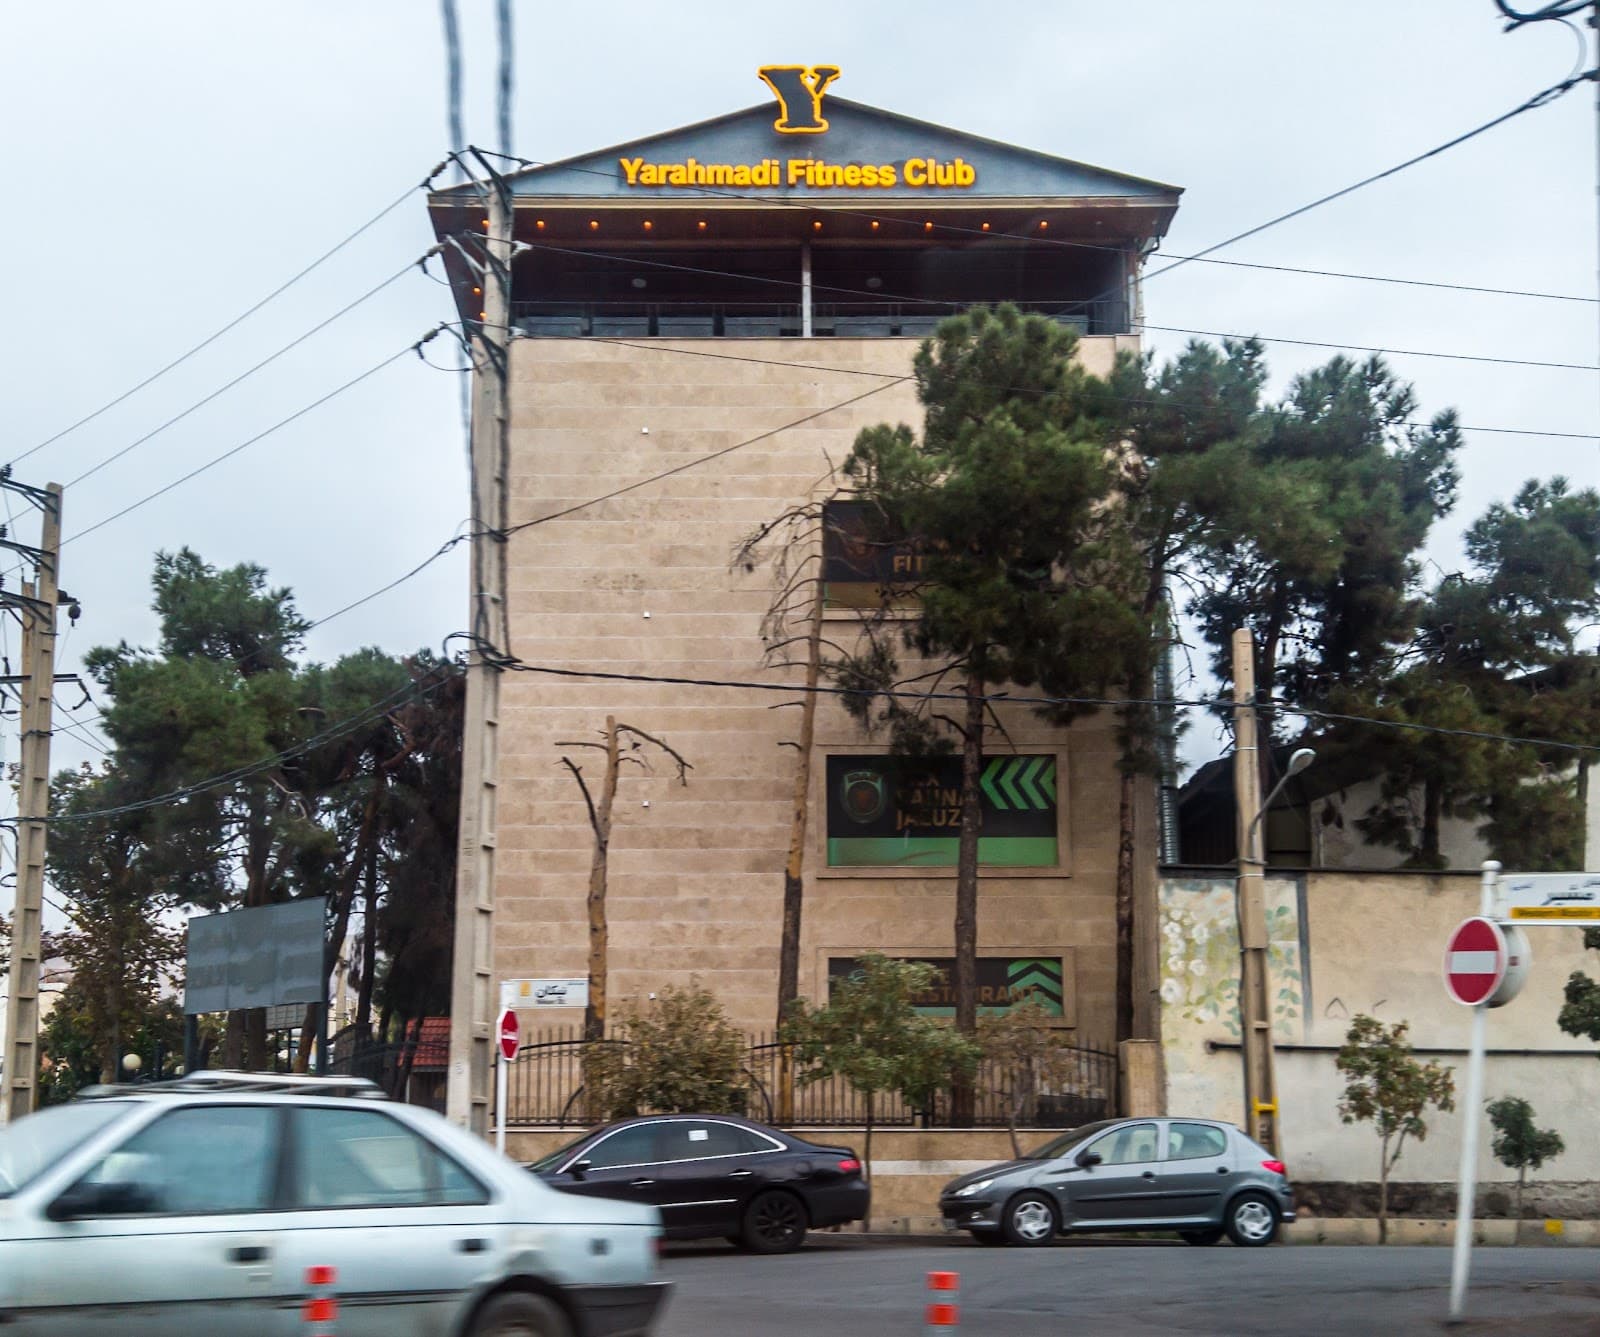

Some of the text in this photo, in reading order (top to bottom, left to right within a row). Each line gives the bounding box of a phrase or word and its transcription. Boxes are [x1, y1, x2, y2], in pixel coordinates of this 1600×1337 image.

[757, 64, 842, 134] Y
[619, 157, 976, 187] Yarahmadi Fitness Club
